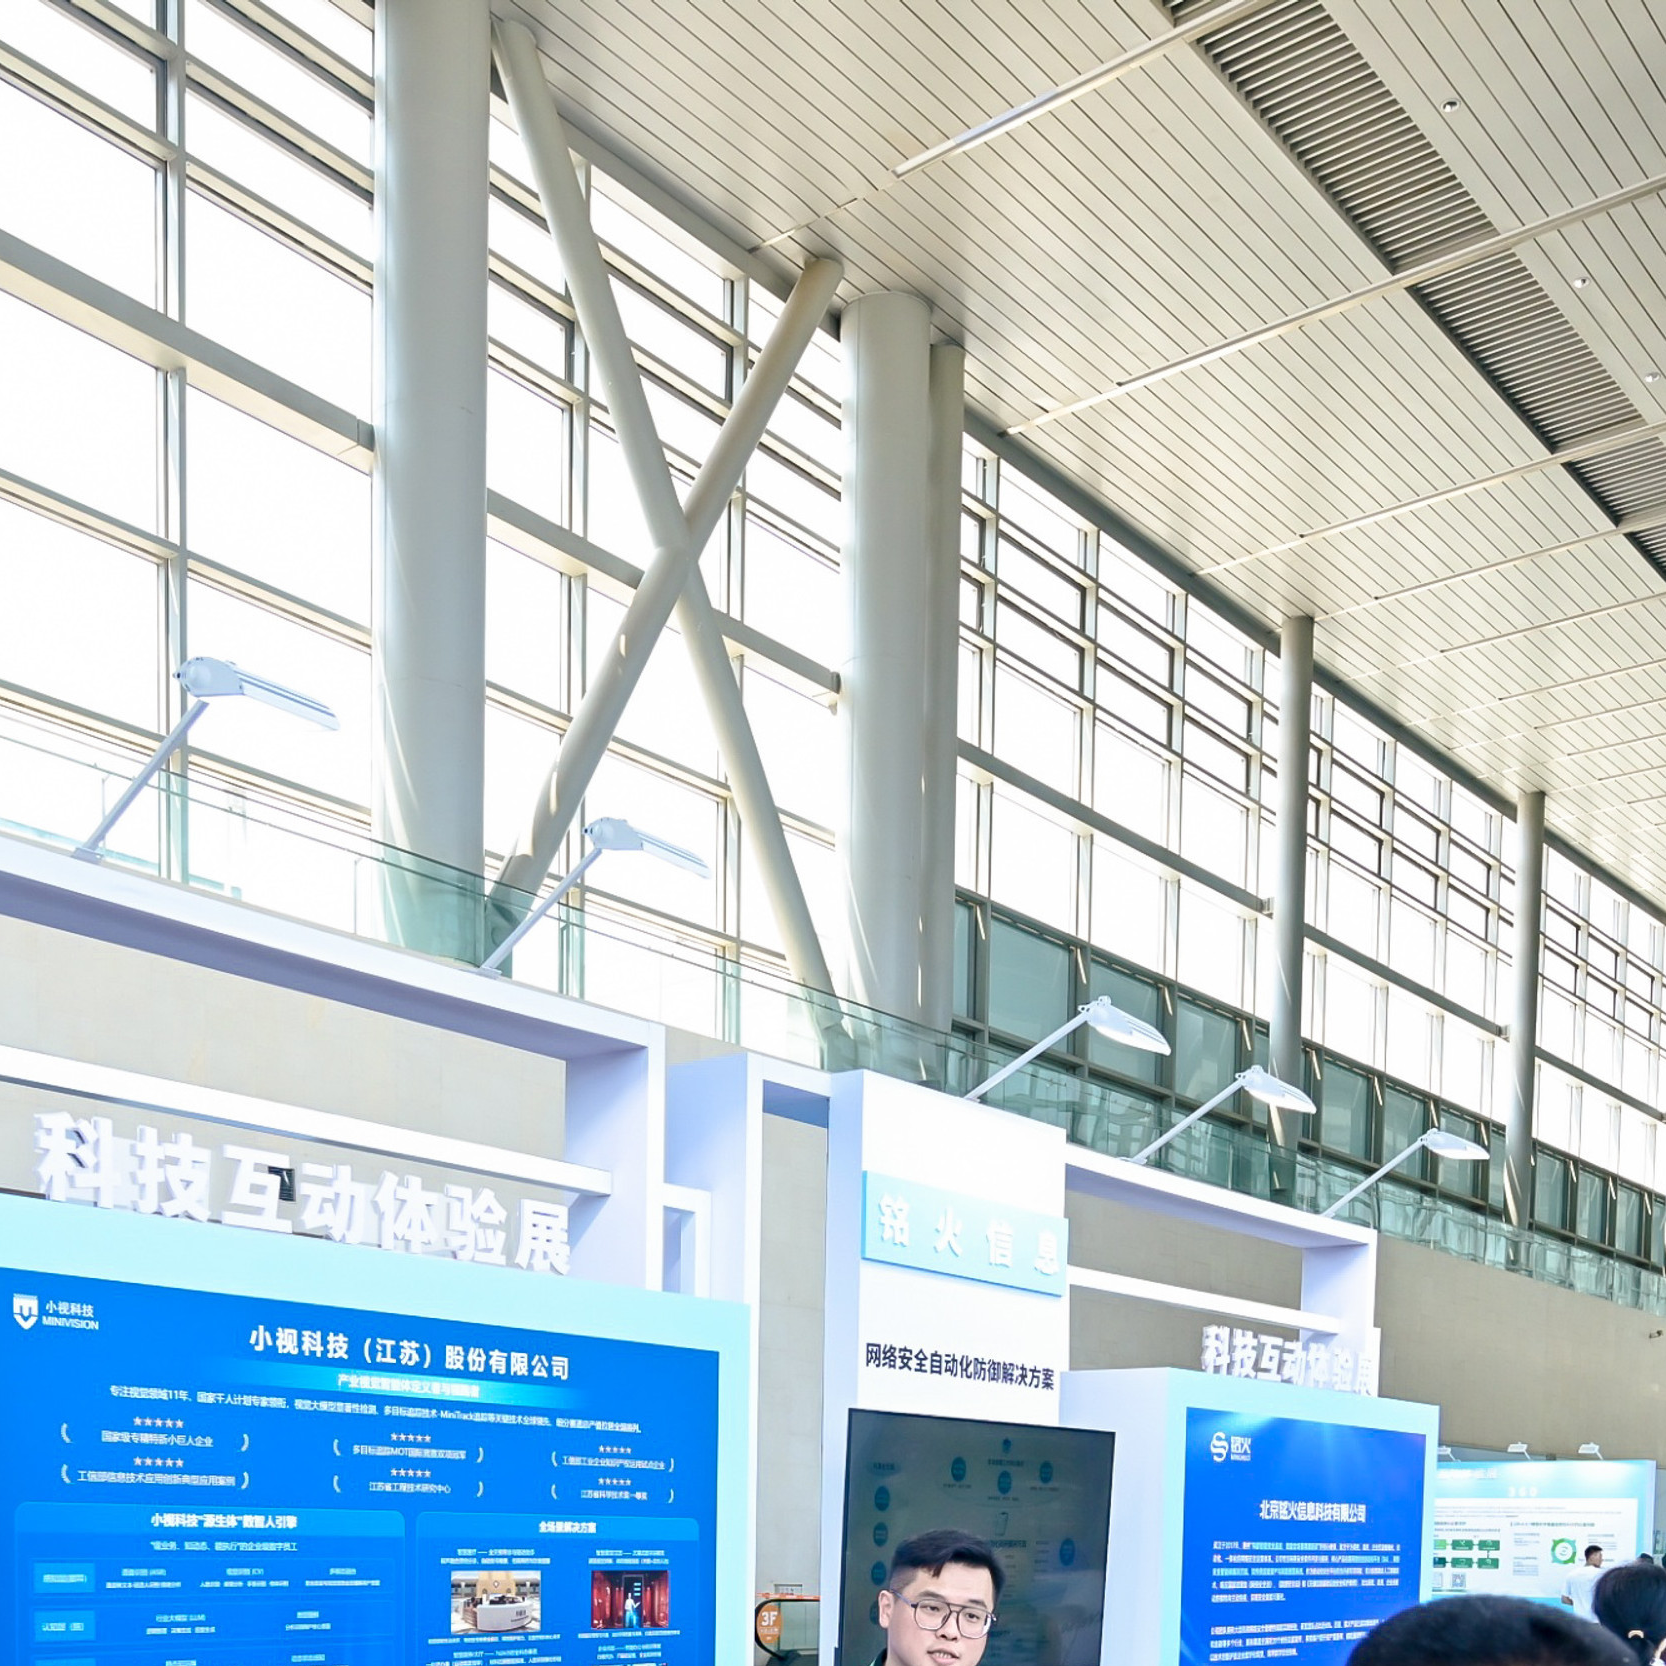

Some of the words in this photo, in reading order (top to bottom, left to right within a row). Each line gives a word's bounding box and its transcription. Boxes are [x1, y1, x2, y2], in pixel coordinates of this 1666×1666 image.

[33, 1111, 571, 1276] 科技互动体验展
[42, 1315, 100, 1331] MINIVISION
[46, 1300, 94, 1318] 小视科技
[865, 1342, 1055, 1390] 网络安全自动化防御解决方案
[1201, 1324, 1375, 1397] 科技互动体验展
